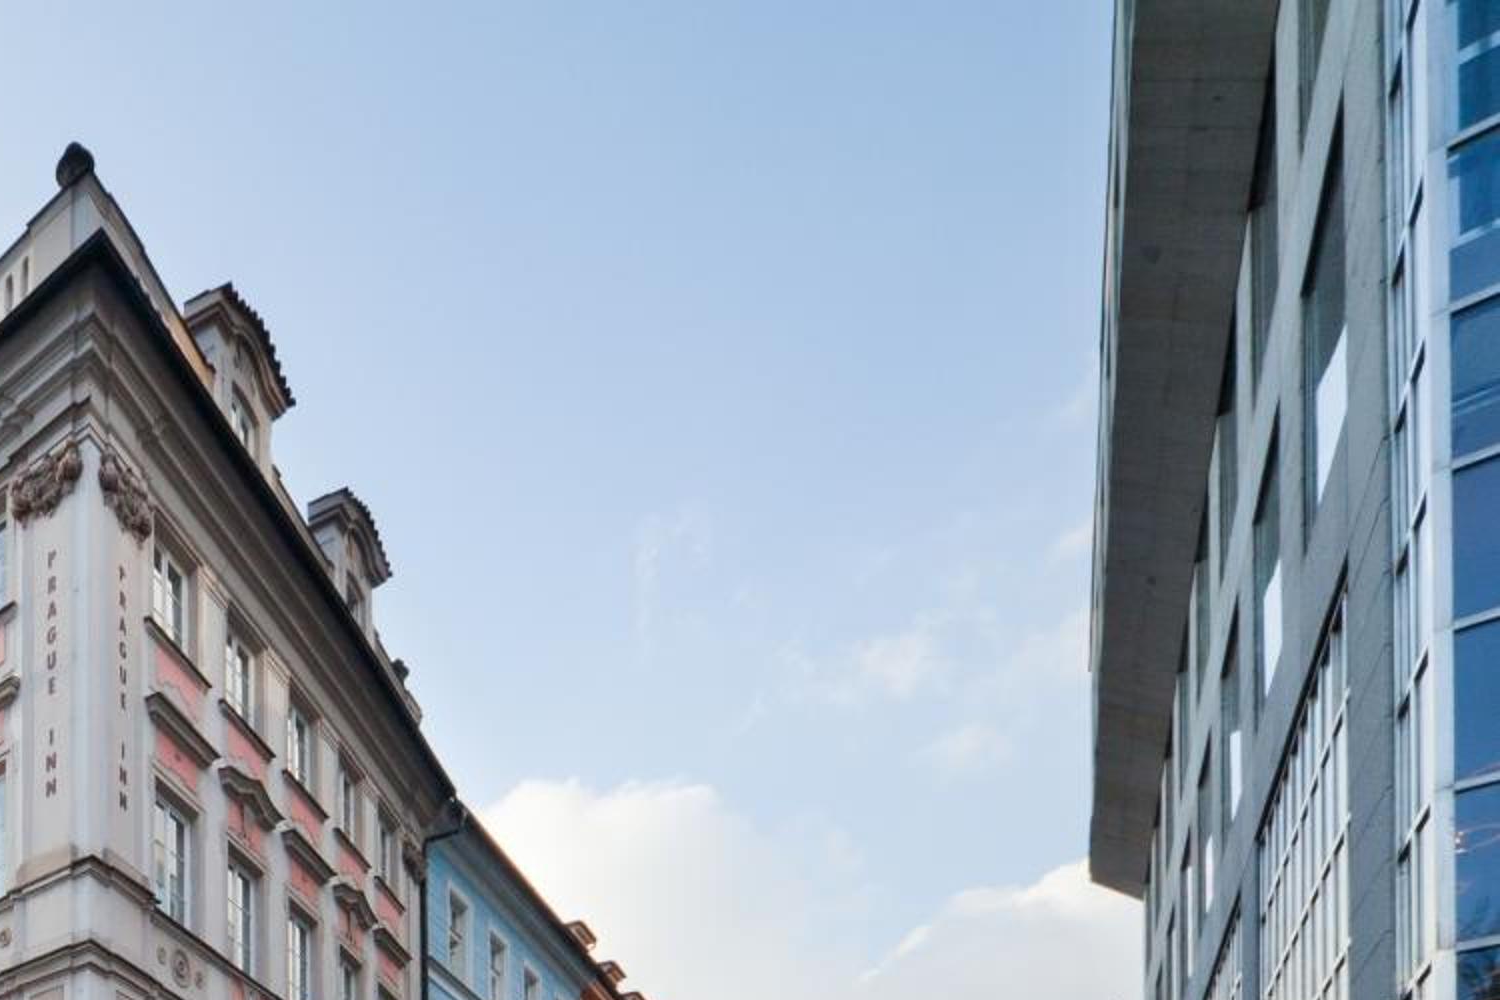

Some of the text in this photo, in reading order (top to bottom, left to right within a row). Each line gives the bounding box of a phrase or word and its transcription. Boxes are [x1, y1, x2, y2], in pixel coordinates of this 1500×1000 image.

[45, 549, 58, 798] PRAGUE INN
[118, 565, 128, 812] PRAGUE INN
